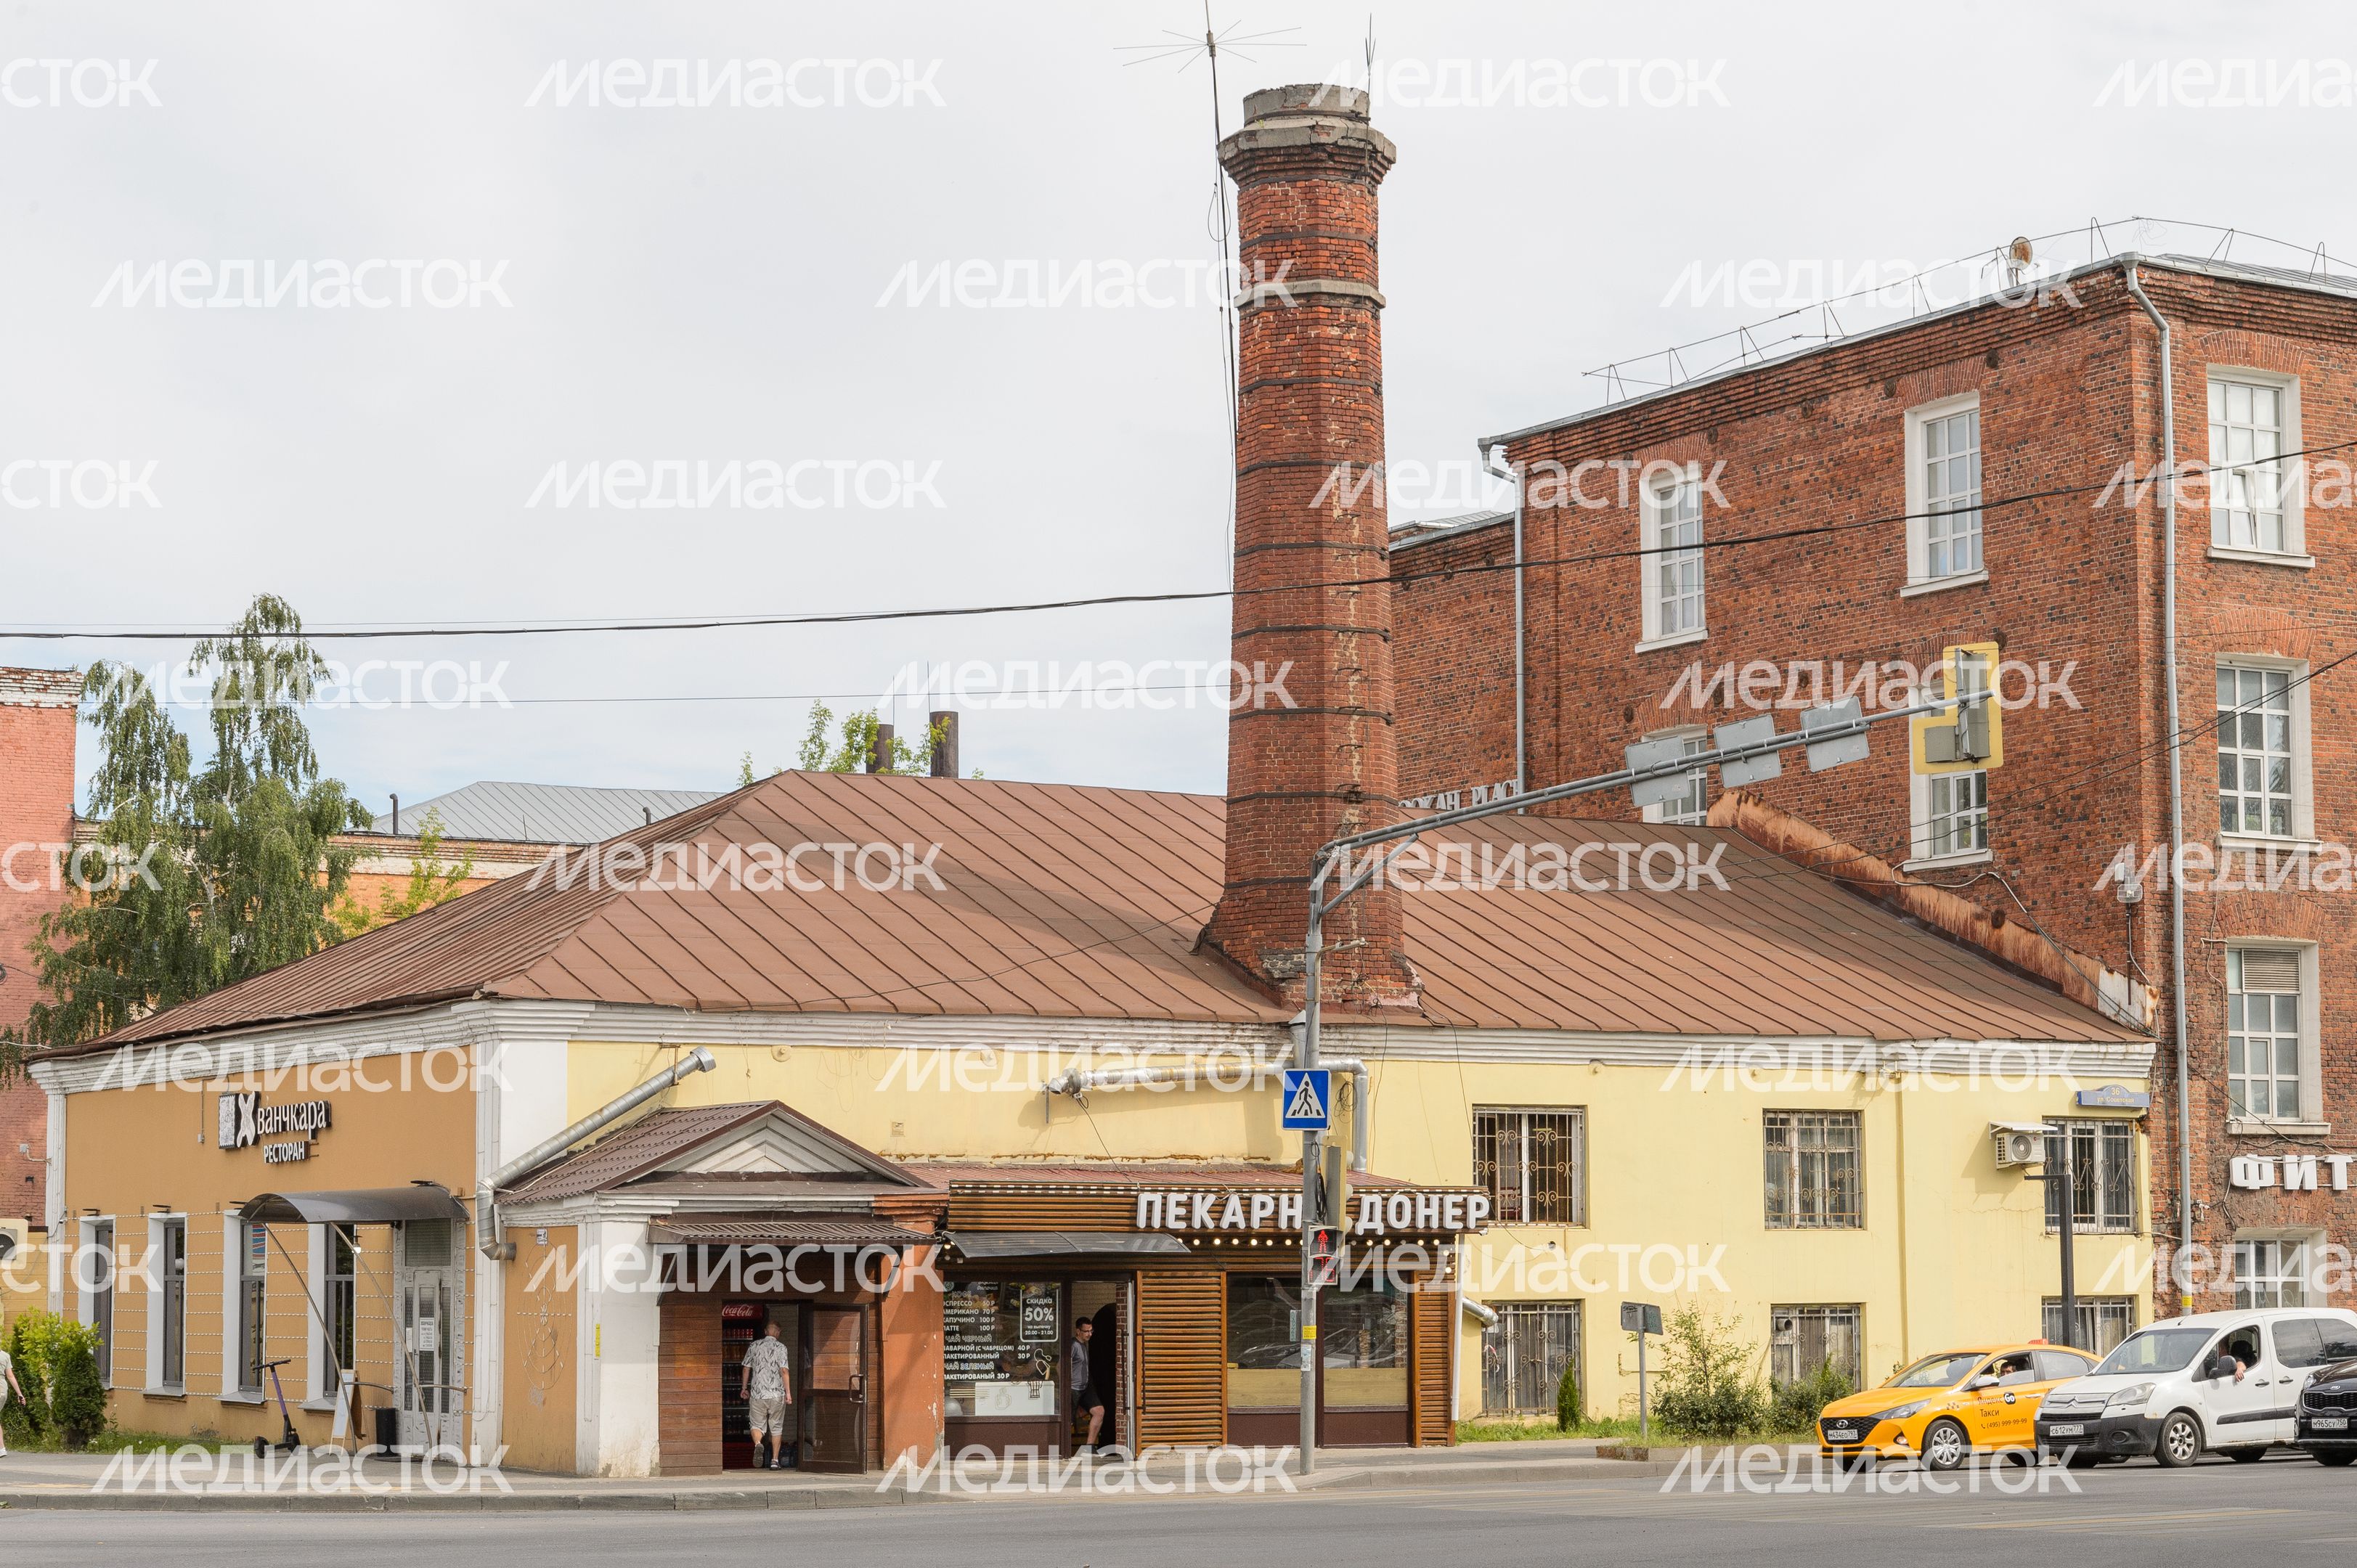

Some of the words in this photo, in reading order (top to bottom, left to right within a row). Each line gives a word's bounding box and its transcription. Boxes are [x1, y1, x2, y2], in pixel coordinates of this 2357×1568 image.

[264, 1141, 305, 1163] РЕСТОРАН
[2229, 1153, 2353, 1191] ФИТ
[1136, 1193, 1303, 1230] ПЕКАРН
[1355, 1194, 1490, 1235] ДОНЕР
[1025, 1307, 1054, 1321] 50%
[1977, 1396, 2003, 1405] Яндекс
[2004, 1393, 2015, 1403] Go
[1980, 1408, 2000, 1418] Такси
[2001, 1418, 2027, 1426] 999-99-99
